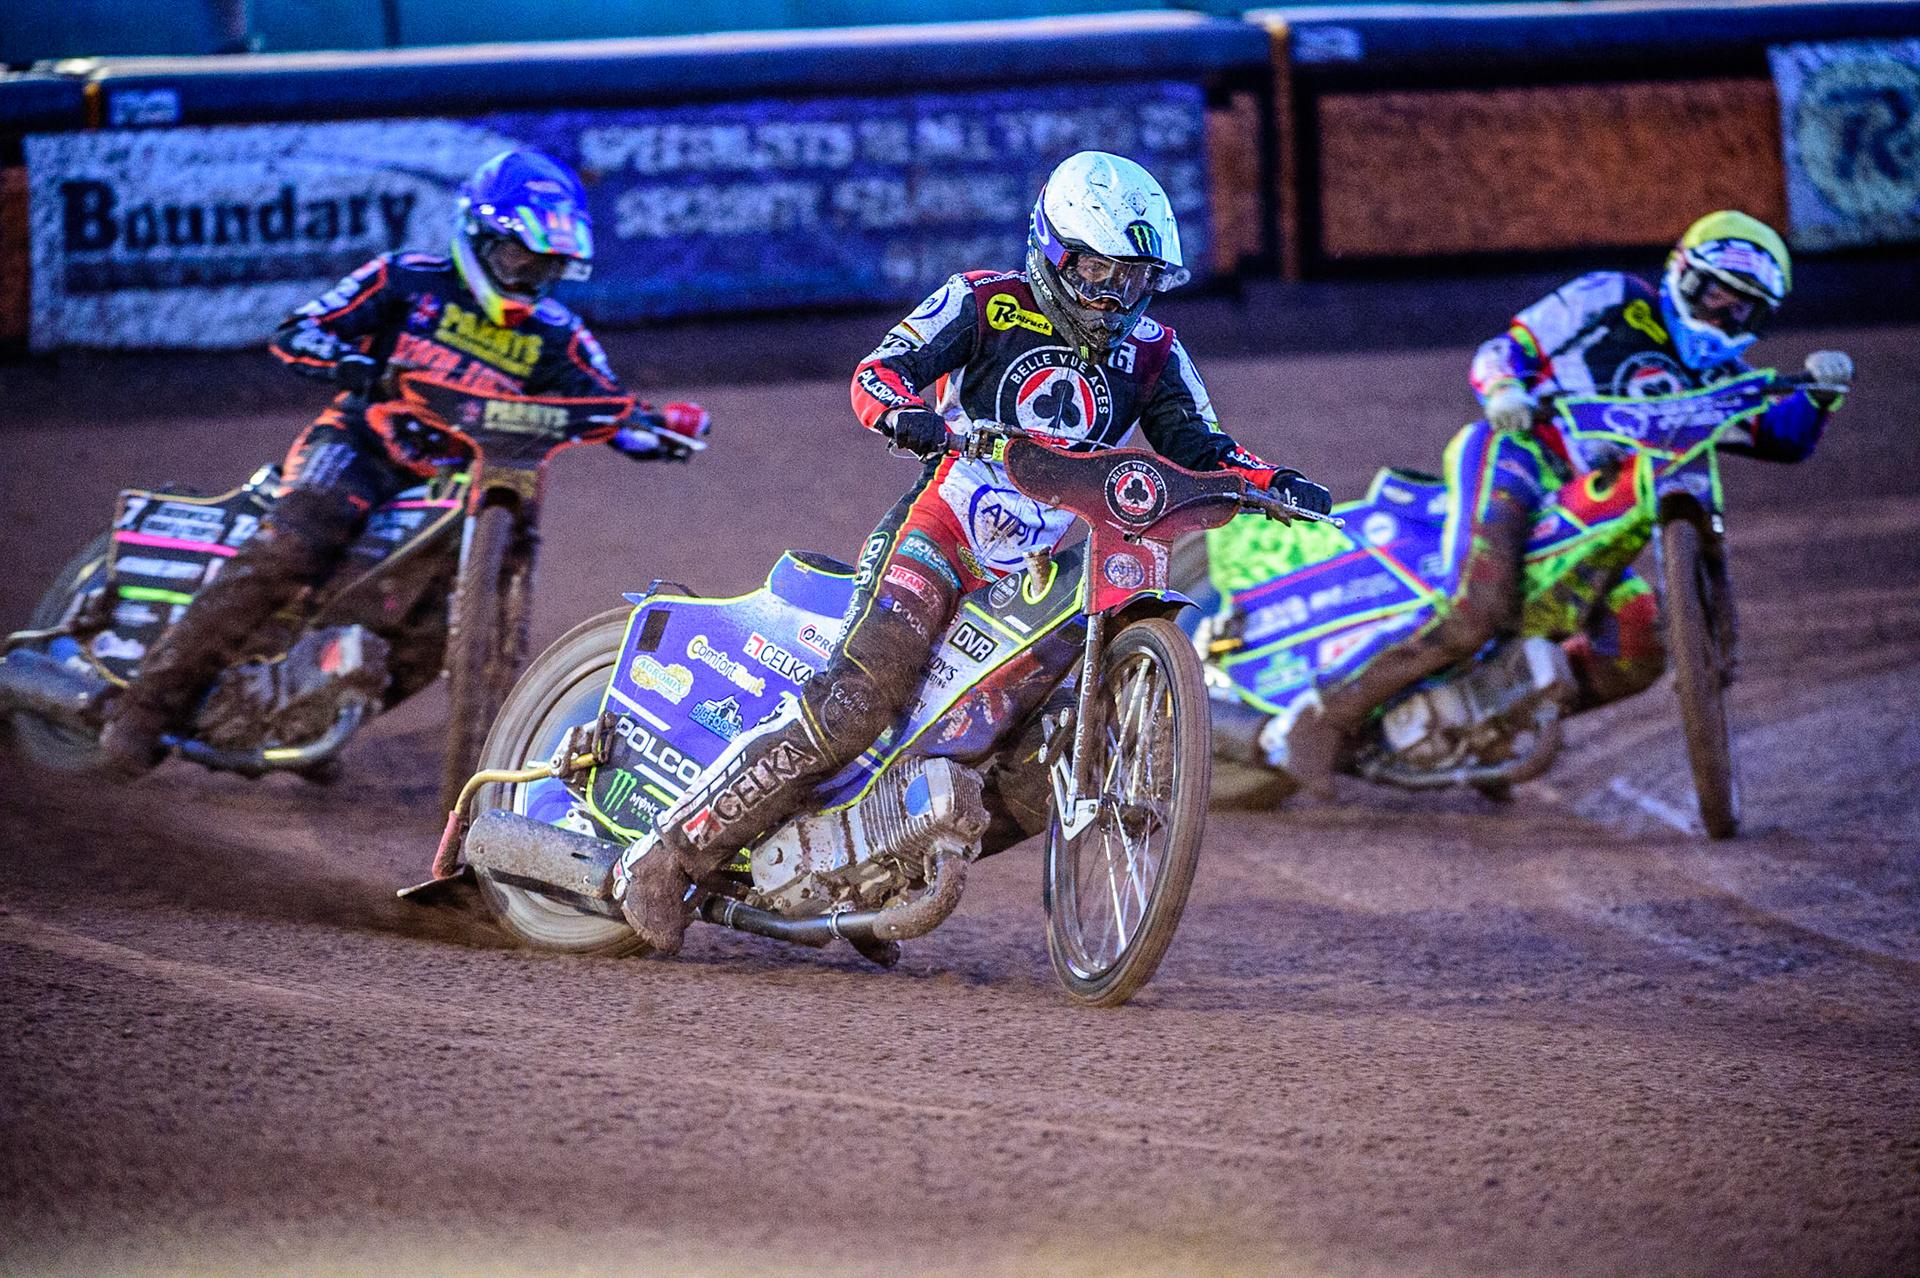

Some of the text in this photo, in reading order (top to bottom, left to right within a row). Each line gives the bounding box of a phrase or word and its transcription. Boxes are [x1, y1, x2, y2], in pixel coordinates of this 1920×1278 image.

[61, 181, 416, 250] Boundary
[993, 300, 1050, 331] Rentruck
[1010, 353, 1109, 415] BELLE VUE ACES
[1132, 463, 1147, 472] VUE
[1149, 471, 1163, 491] ACES
[855, 538, 885, 586] DVR
[952, 624, 994, 661] DVR
[639, 660, 683, 694] AGROMIX
[760, 645, 812, 683] CELKA
[692, 703, 737, 736] BIGFOOT
[615, 716, 702, 785] POLCO
[713, 743, 817, 823] CELKA
